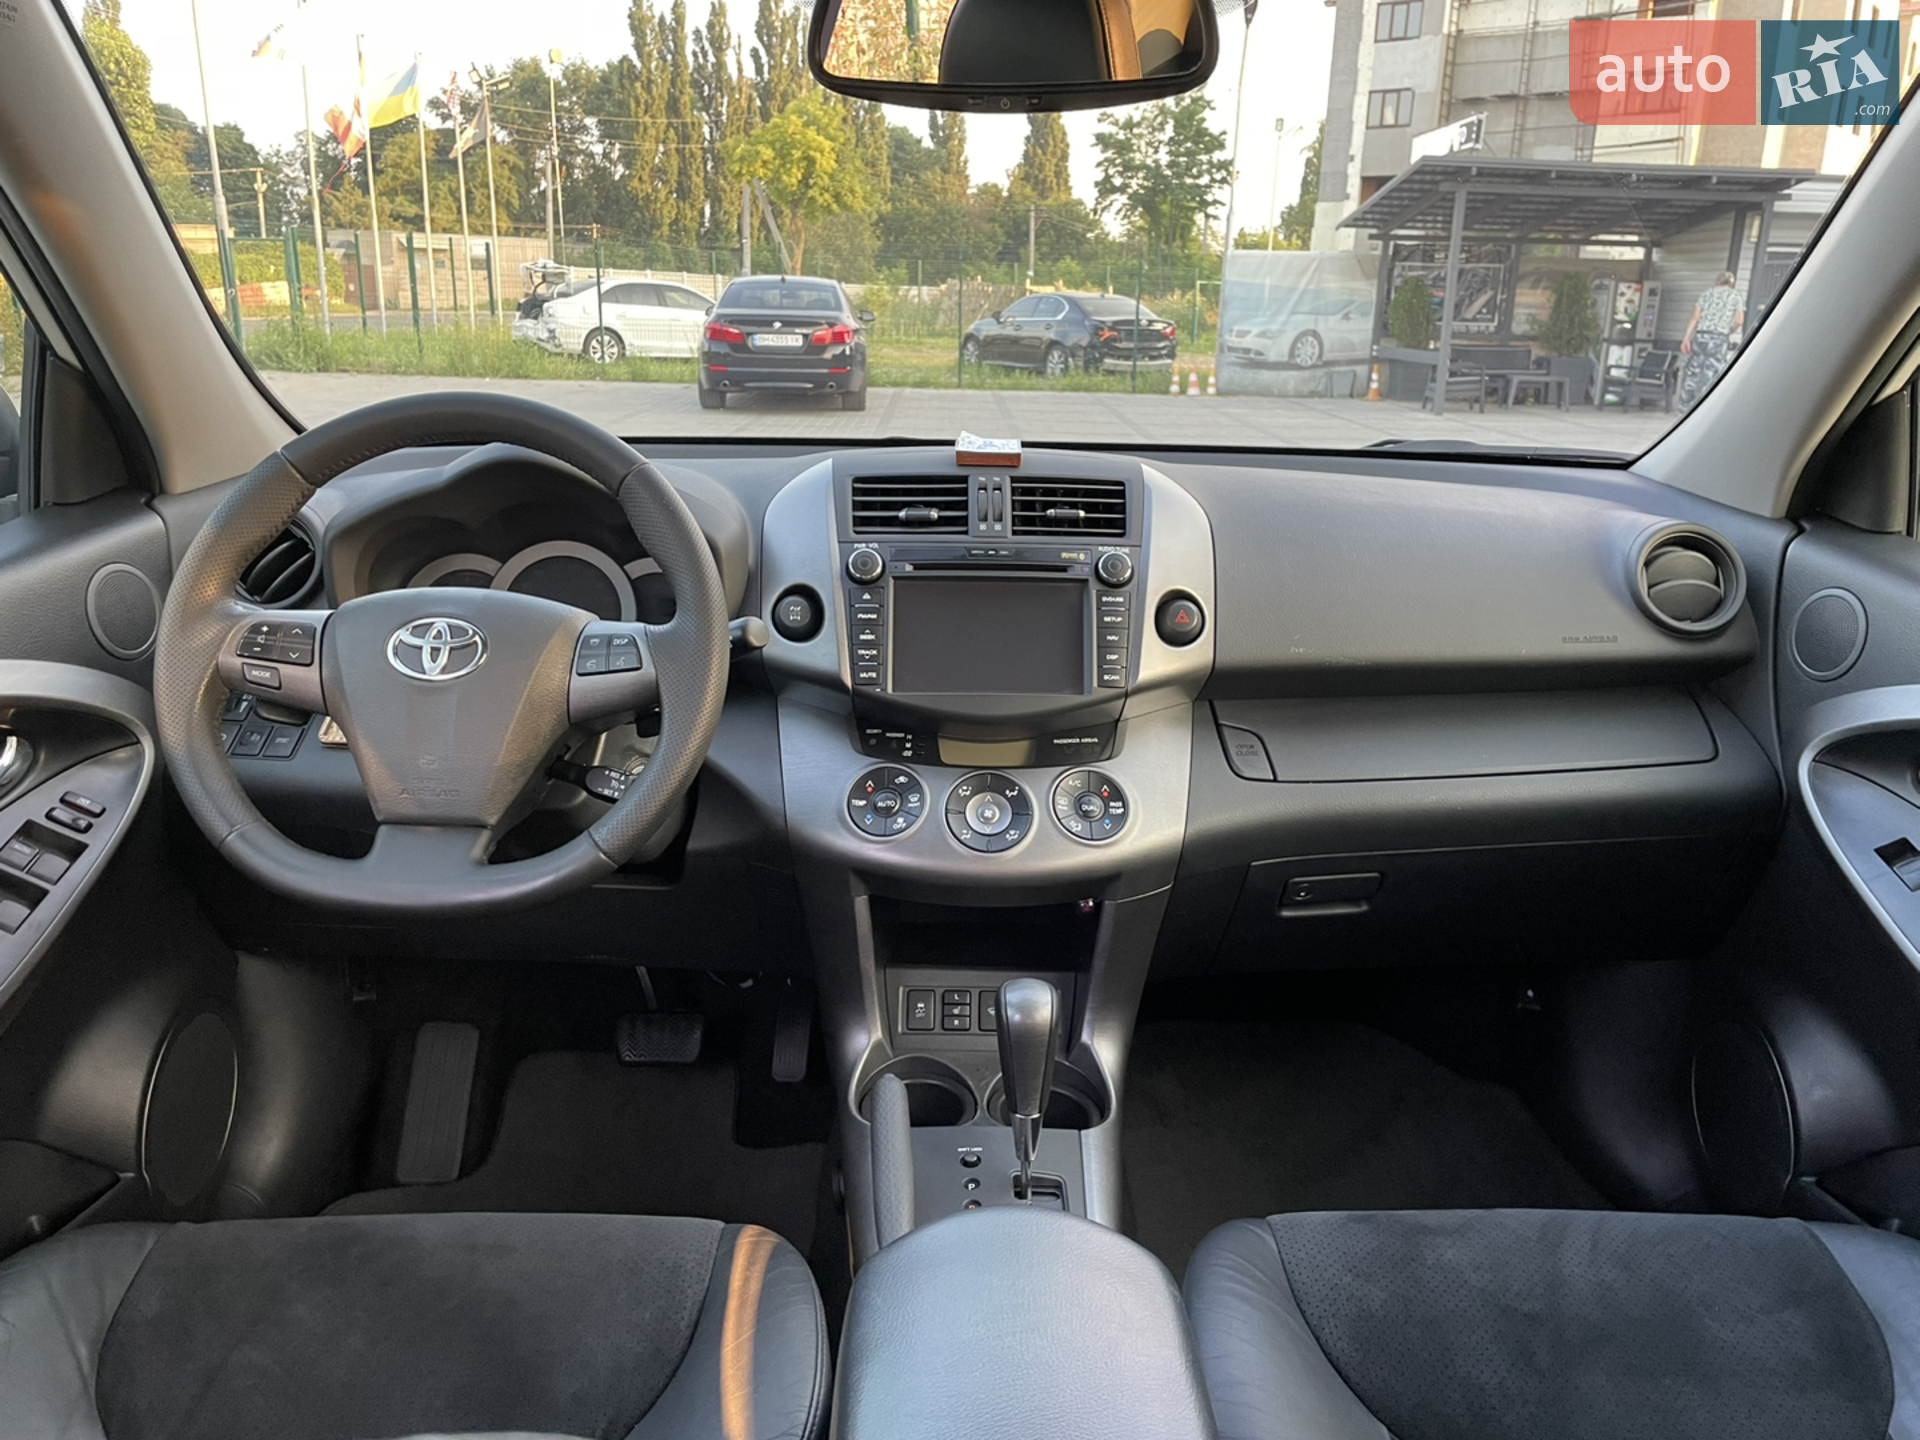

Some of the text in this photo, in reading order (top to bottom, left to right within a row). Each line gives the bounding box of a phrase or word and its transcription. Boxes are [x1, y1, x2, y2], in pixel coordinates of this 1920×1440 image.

[1103, 615, 1123, 623] SETUP
[251, 669, 272, 678] MODE
[1068, 779, 1082, 788] A/C
[851, 799, 868, 807] TEMP
[1080, 803, 1099, 812] DUAL
[968, 1183, 976, 1191] P
